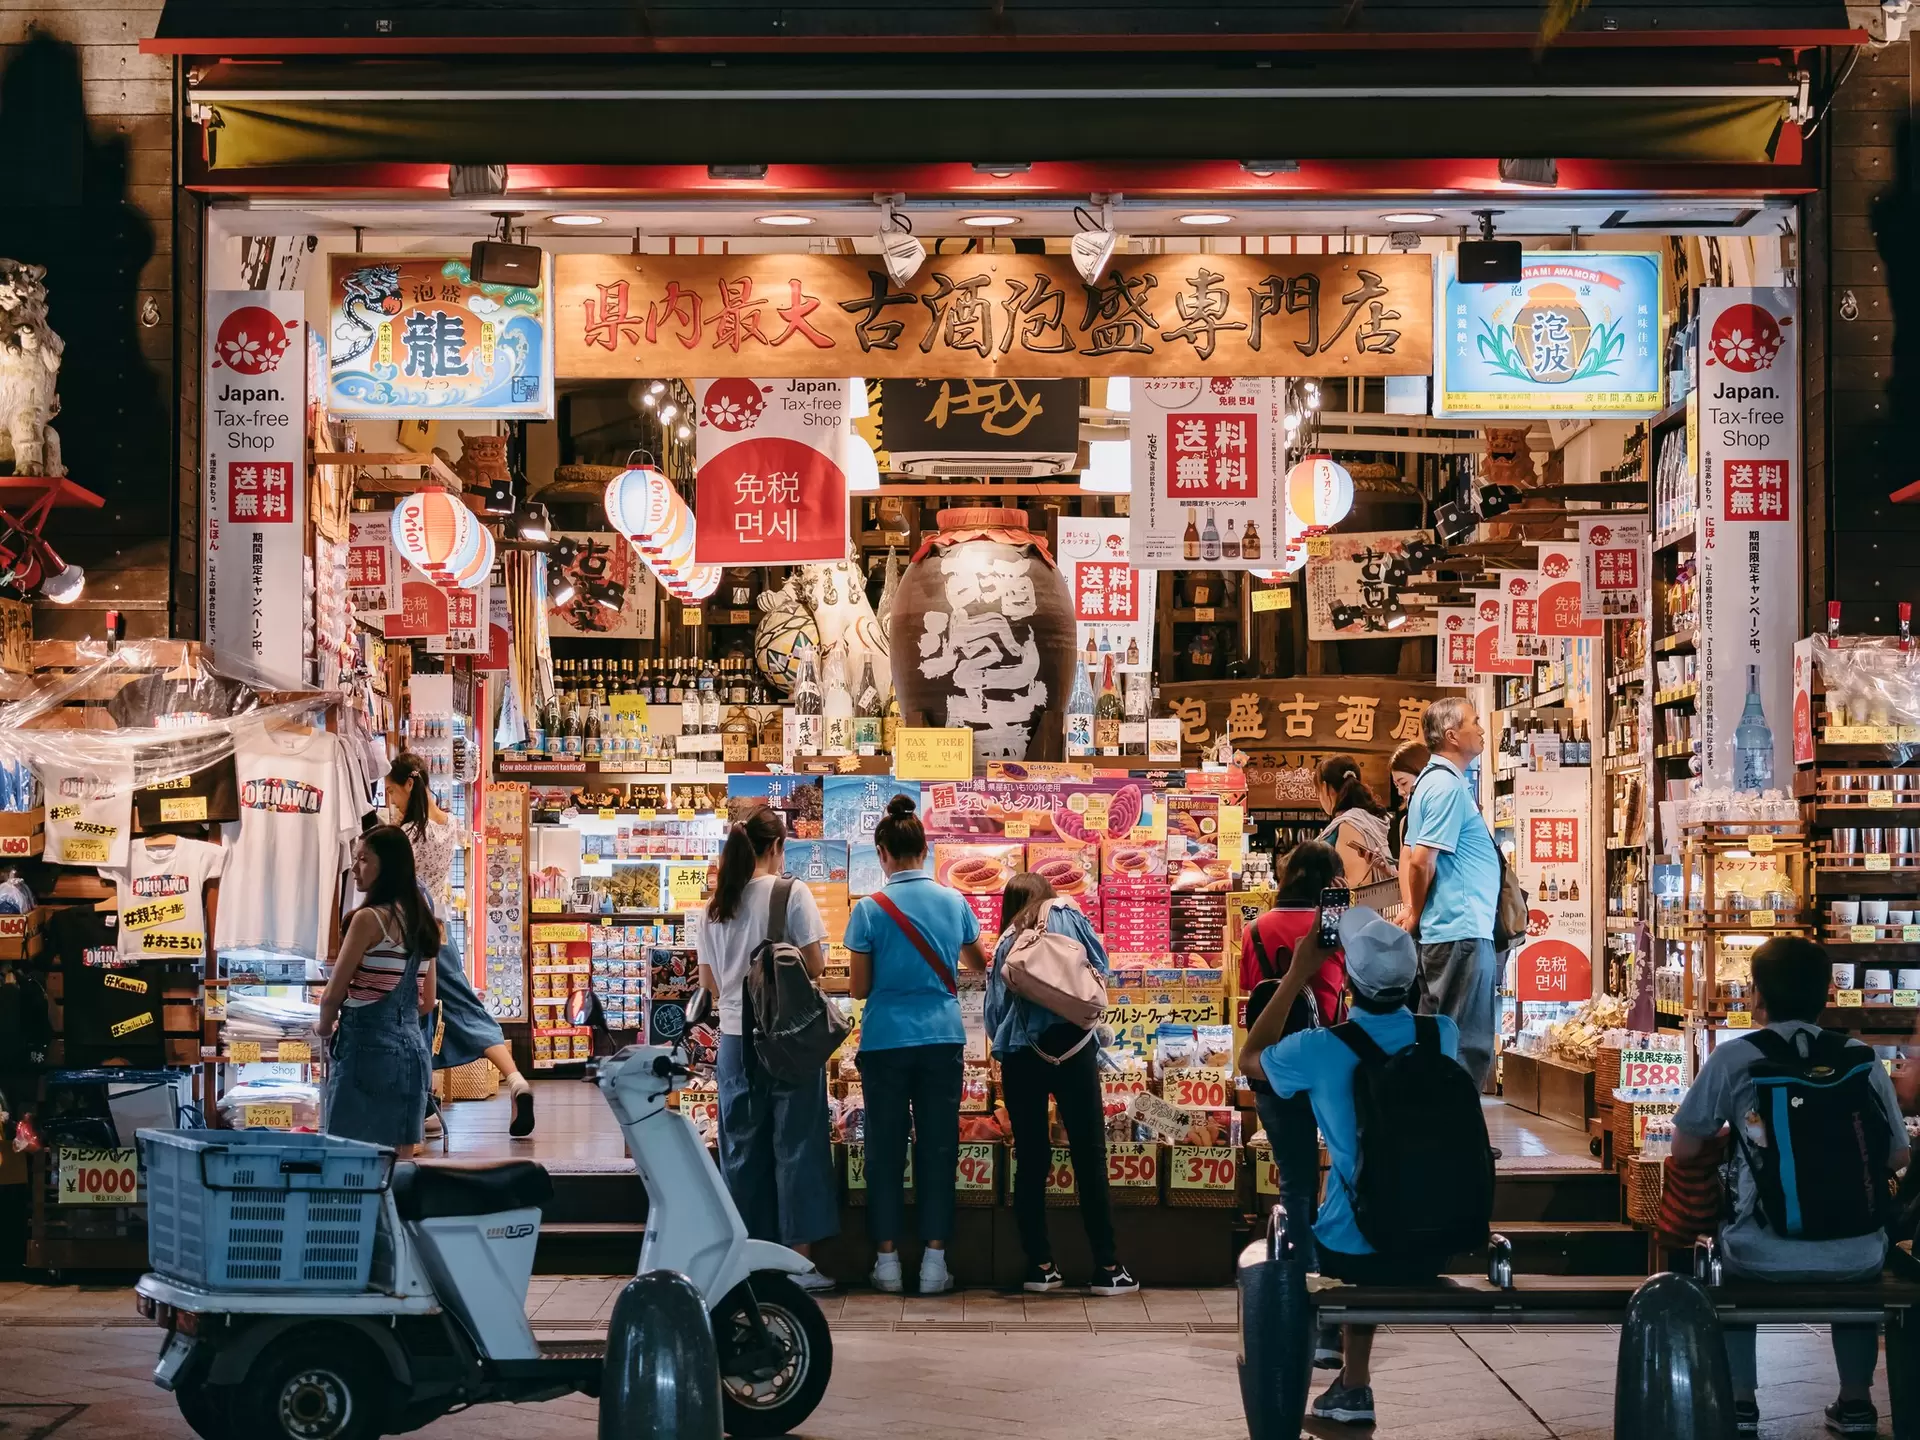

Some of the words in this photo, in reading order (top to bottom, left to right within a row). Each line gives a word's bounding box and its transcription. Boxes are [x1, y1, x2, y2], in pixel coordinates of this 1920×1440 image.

[1554, 268, 1600, 283] AWAMORI
[413, 285, 461, 304] 泡盛
[402, 310, 468, 378] 龍
[1533, 312, 1572, 375] 泡波
[218, 384, 285, 406] Japan.
[787, 379, 842, 394] Japan.
[1713, 383, 1780, 403] Japan.
[780, 397, 842, 411] Tax-free
[1219, 397, 1236, 406] 免税
[214, 410, 289, 428] Tax-free
[803, 413, 842, 428] Shop
[1708, 408, 1784, 426] Tax-free
[227, 432, 275, 453] Shop
[1175, 420, 1247, 454] 送料
[1722, 430, 1770, 451] Shop
[234, 466, 286, 491] 送料
[1176, 456, 1248, 490] 無料
[1730, 465, 1781, 489] 送料
[734, 472, 800, 505] 免税
[235, 493, 286, 518] 無料
[650, 480, 664, 522] Orion
[1730, 491, 1782, 516] 無料
[404, 506, 423, 553] Orion
[734, 509, 798, 544] 면세
[1600, 552, 1633, 569] 送料
[1081, 566, 1132, 591] 送料
[1600, 570, 1632, 585] 無料
[1081, 591, 1132, 616] 無料
[905, 738, 926, 746] TAX
[936, 738, 964, 746] FREE
[905, 751, 928, 761] 免税
[244, 785, 319, 810] OKINAWA
[768, 781, 782, 809] 沖縄
[865, 781, 879, 809] 沖縄
[958, 792, 1064, 812] 紅いもタルト
[1535, 821, 1573, 839] 送料
[65, 851, 97, 861] ¥2,160
[1535, 841, 1573, 858] 無料
[134, 879, 188, 893] OKINAWA
[676, 870, 706, 885] 点検
[1558, 920, 1587, 928] Tax-free
[1560, 911, 1586, 920] Japan.
[1535, 956, 1567, 972] 免税
[1535, 974, 1567, 991] 면세
[272, 1065, 296, 1076] Shop
[1625, 1064, 1680, 1087] 1388
[1177, 1081, 1224, 1106] 300
[1634, 1104, 1680, 1115] 沖縄限定
[248, 1117, 281, 1126] ¥2,160
[1106, 1144, 1145, 1155] まい棒
[1175, 1147, 1231, 1158] ファミリーパック
[1109, 1155, 1155, 1180] 550
[1188, 1157, 1234, 1184] 370
[78, 1168, 135, 1193] 1000
